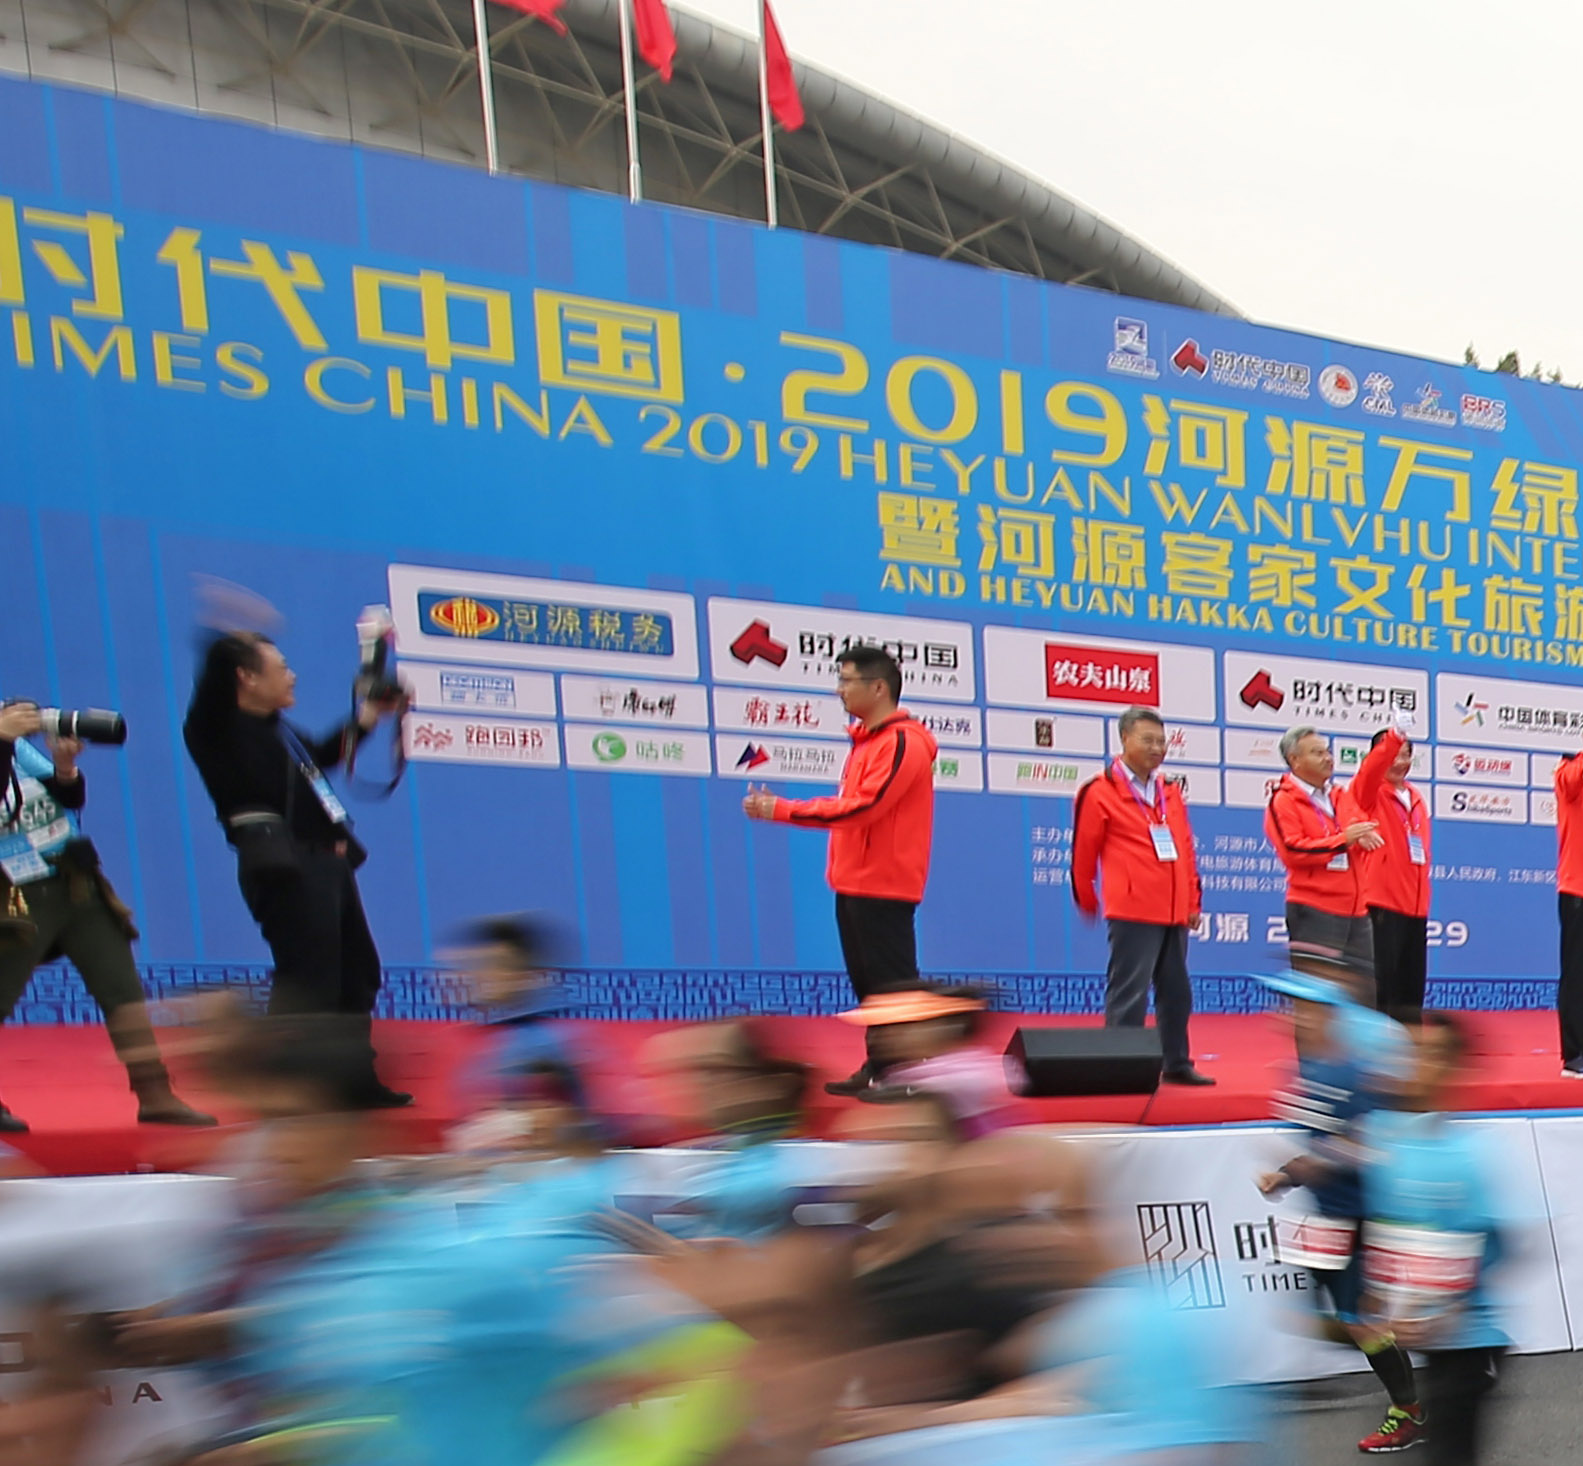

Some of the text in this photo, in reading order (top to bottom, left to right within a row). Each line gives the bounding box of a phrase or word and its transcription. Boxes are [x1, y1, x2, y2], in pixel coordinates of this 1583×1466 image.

[12, 311, 270, 399] IMES
[304, 358, 613, 448] CHINA
[637, 405, 820, 474] 2019
[838, 432, 1131, 518] HEYUAN
[1148, 480, 1451, 562] WANLVHU
[880, 564, 966, 597] AND
[980, 575, 1134, 617] HEYUAN
[1148, 594, 1274, 634] HAKKA
[1285, 611, 1439, 651] CULTURE
[1052, 659, 1152, 694] 农夫山泉
[1293, 679, 1417, 712] 时代中国
[1242, 1272, 1310, 1293] TIME
